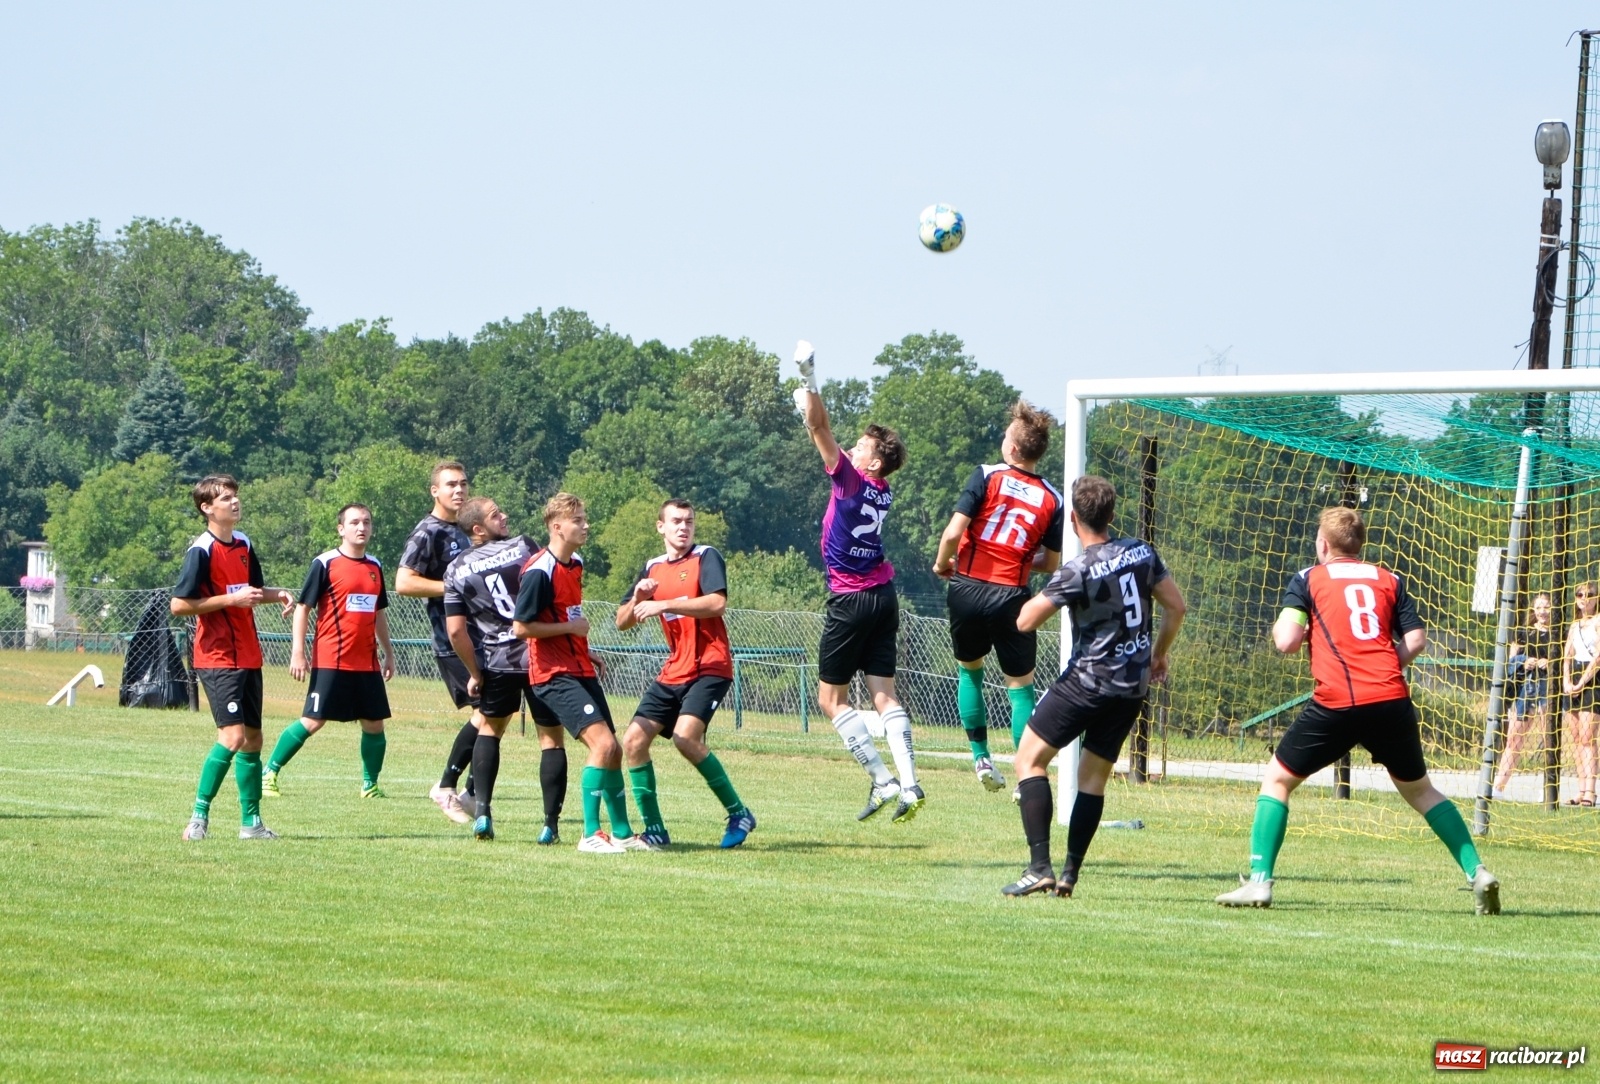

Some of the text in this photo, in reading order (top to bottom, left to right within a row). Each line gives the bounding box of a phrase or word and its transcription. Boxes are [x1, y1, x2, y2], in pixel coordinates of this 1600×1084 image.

[863, 485, 878, 500] KS
[980, 503, 1037, 548] 16
[1089, 560, 1110, 580] LKS
[485, 572, 516, 620] 8
[1118, 572, 1142, 628] 9
[1343, 583, 1381, 641] 8
